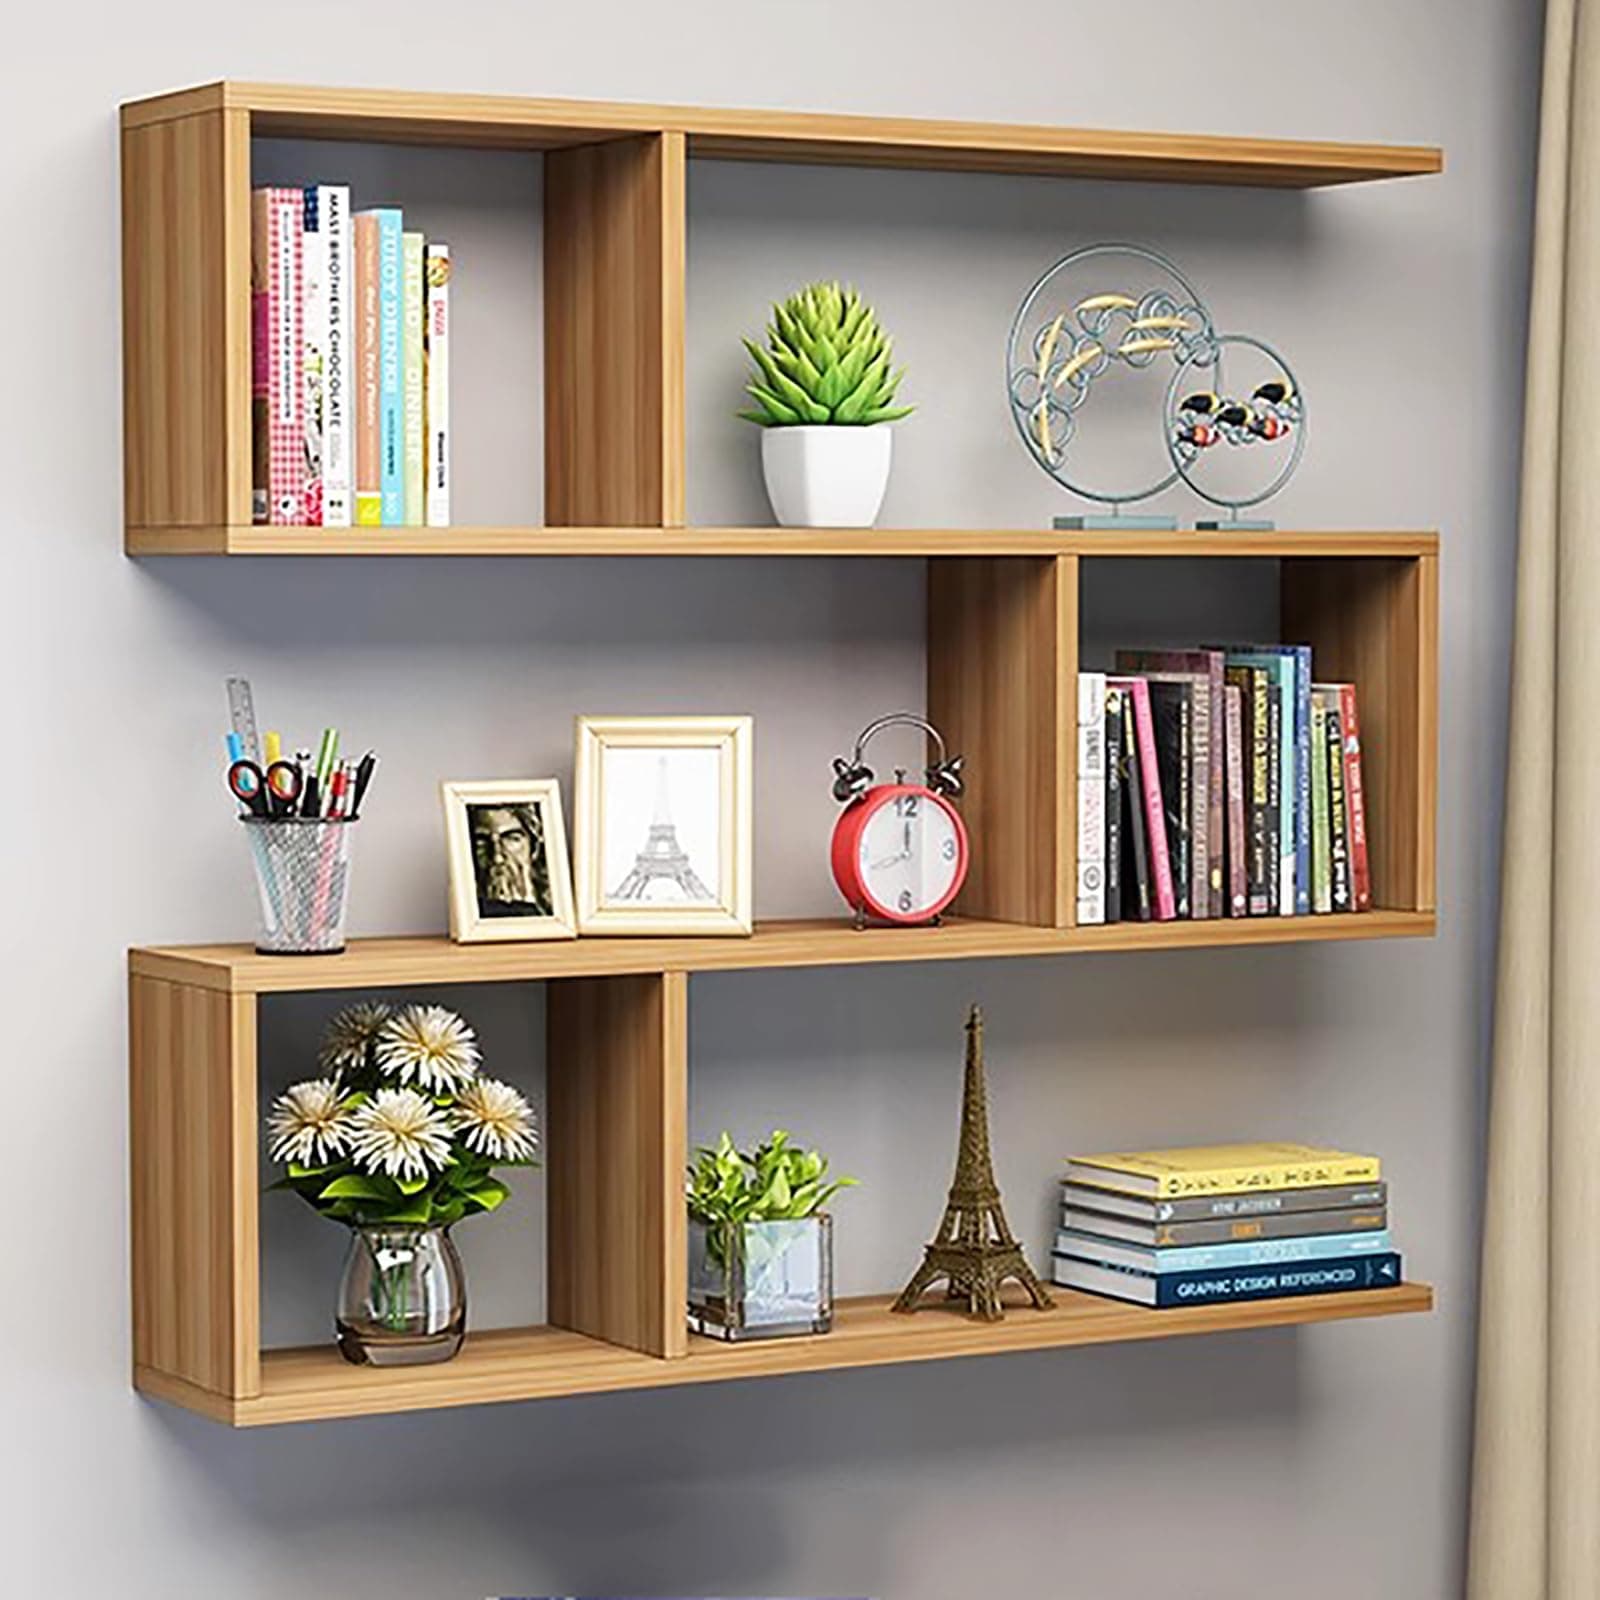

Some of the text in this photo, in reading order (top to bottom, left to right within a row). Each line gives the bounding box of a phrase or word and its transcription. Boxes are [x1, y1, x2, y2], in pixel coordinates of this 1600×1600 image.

[328, 192, 341, 235] MAST
[328, 240, 341, 325] BROTHERS
[382, 225, 399, 296] JUICY
[404, 247, 422, 325] SALAD
[328, 329, 341, 428] CHOCOLATE
[404, 367, 422, 463] DINNER
[893, 797, 918, 817] 12
[942, 840, 955, 861] 3
[898, 891, 912, 911] 6
[1177, 1267, 1356, 1298] GRAPHIC DESIGN REFERENCED
